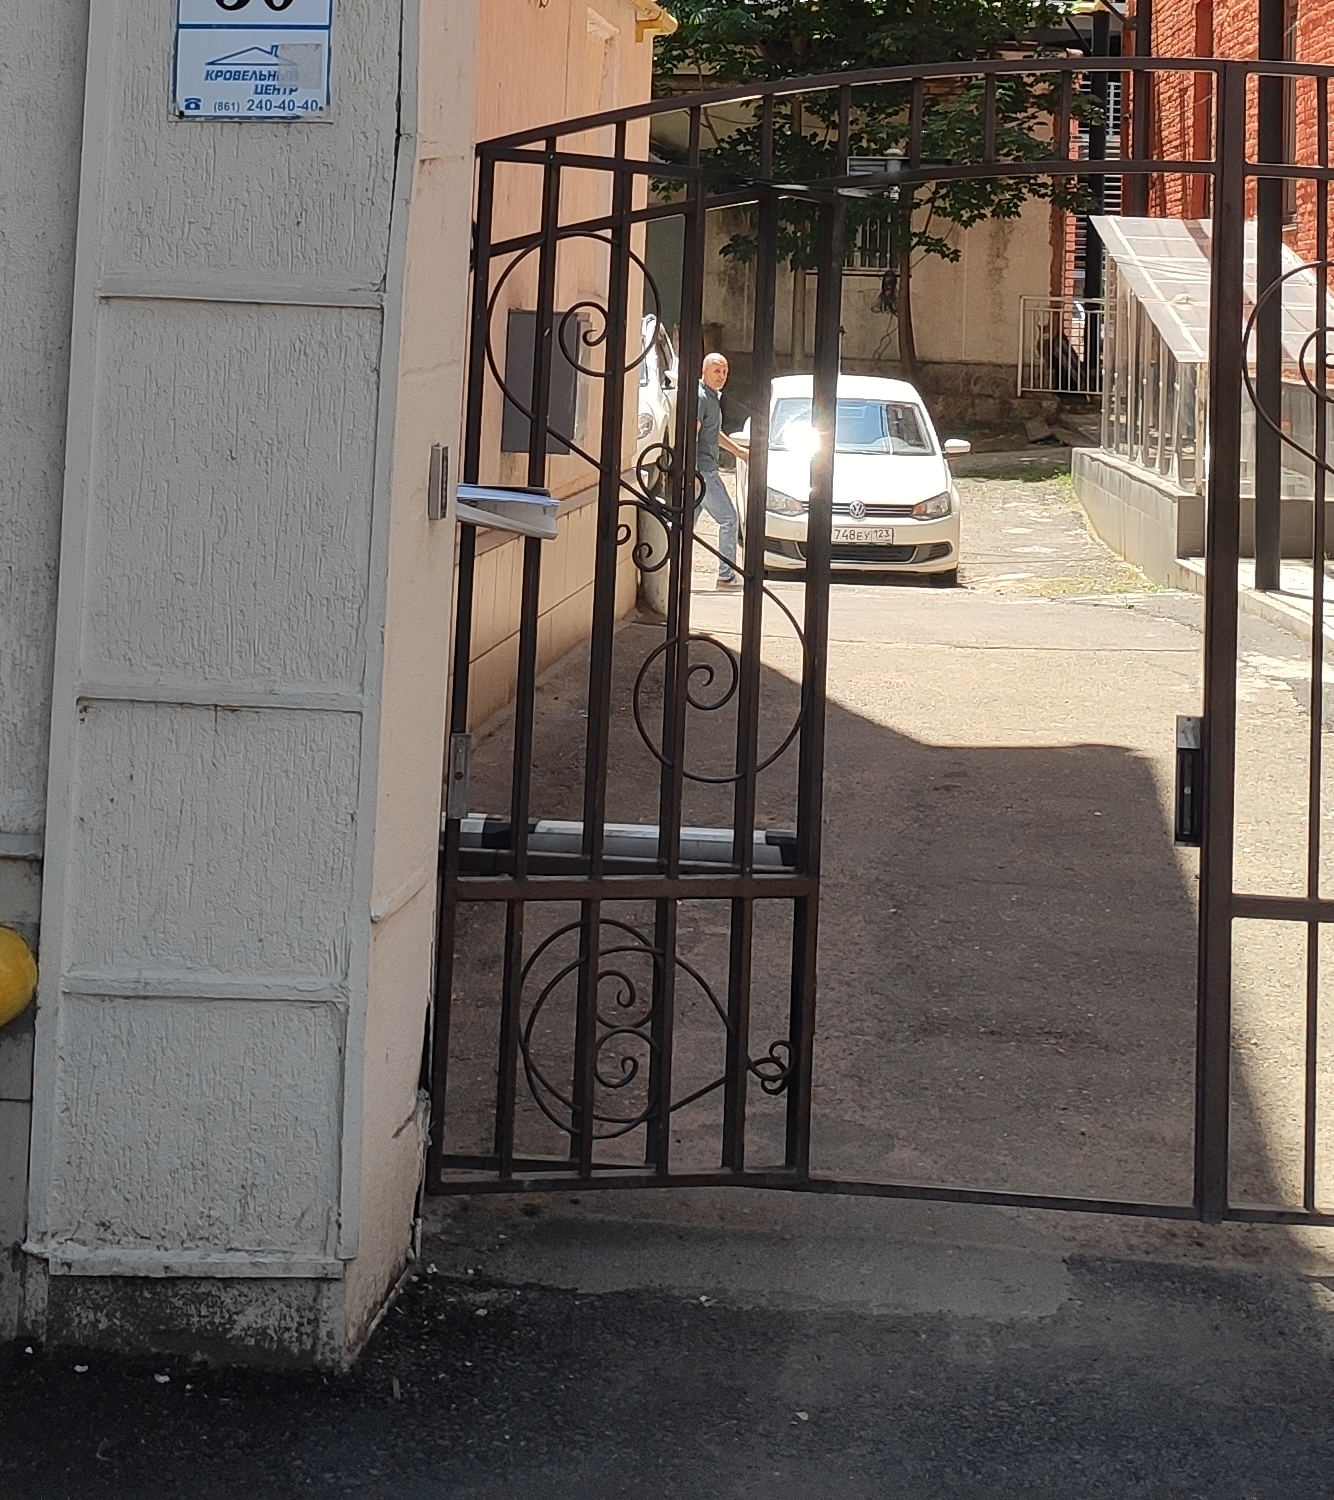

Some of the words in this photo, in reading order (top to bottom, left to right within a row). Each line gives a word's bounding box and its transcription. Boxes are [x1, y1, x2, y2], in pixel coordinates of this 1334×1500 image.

[204, 69, 298, 82] КРОВЕЛЬН
[213, 101, 240, 113] (861)
[246, 98, 319, 112] 240-40-40
